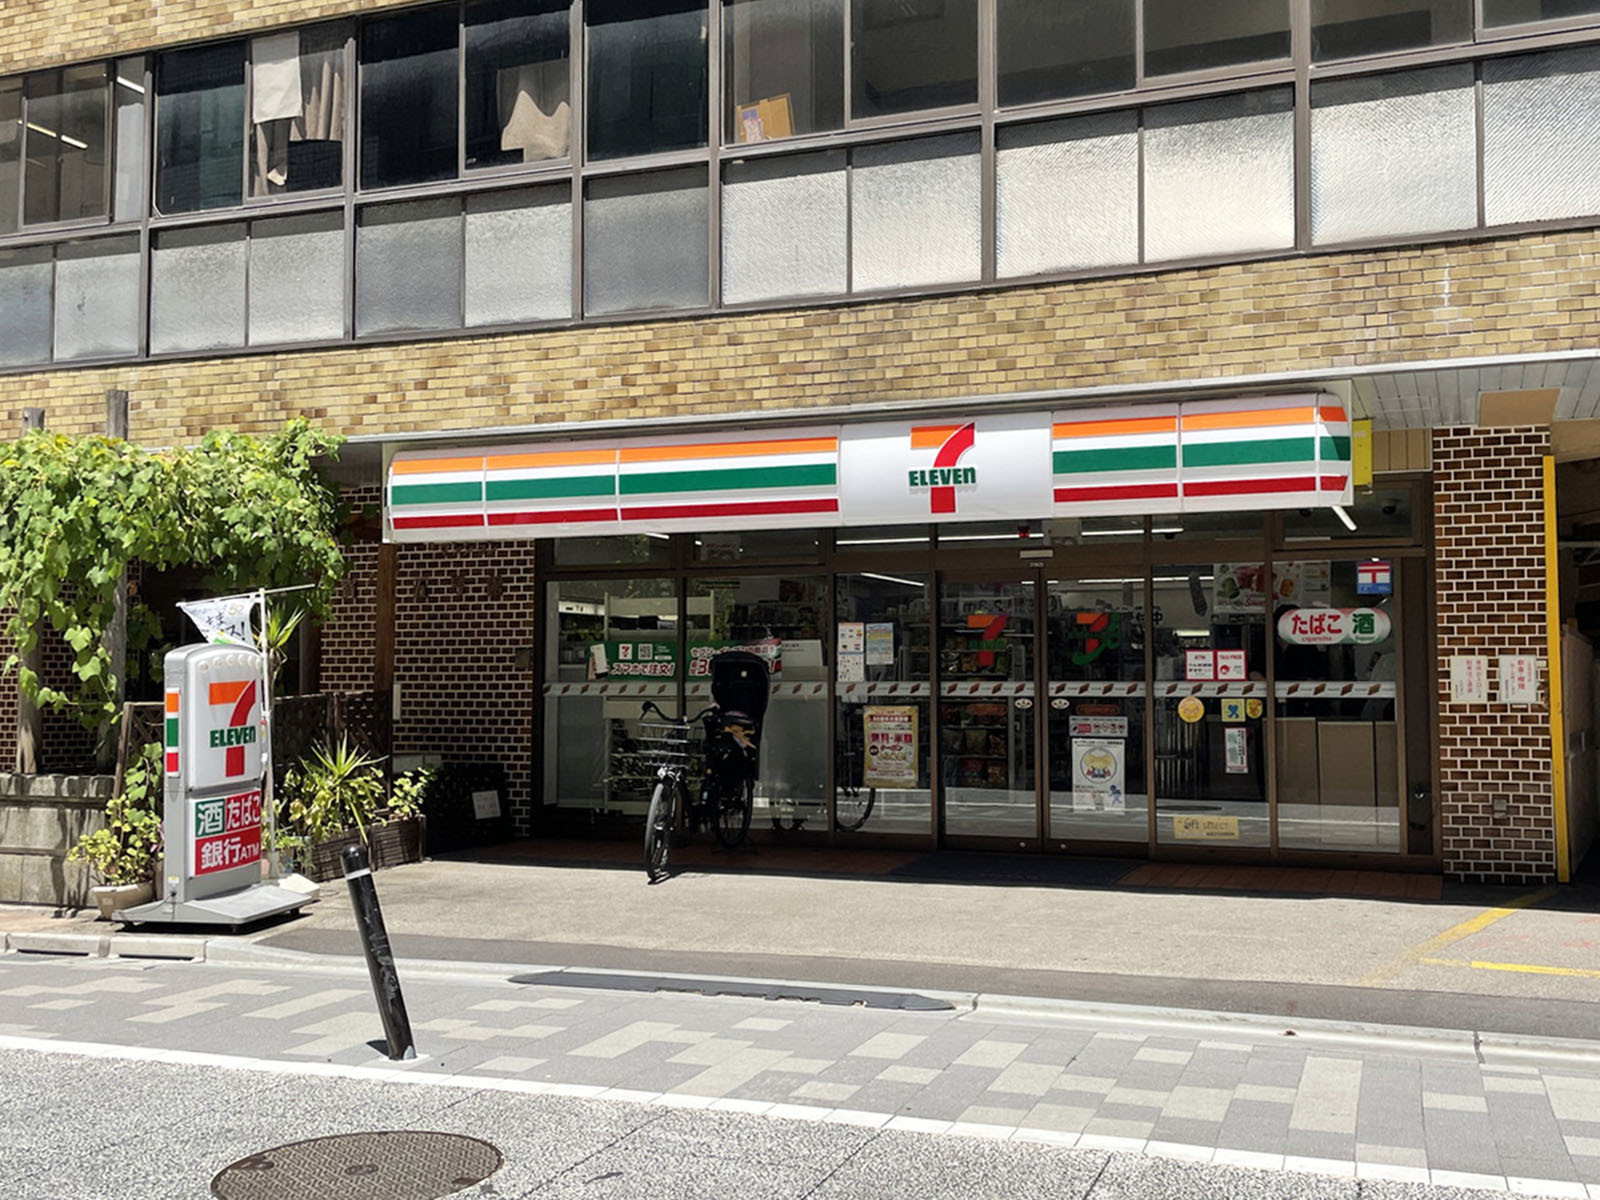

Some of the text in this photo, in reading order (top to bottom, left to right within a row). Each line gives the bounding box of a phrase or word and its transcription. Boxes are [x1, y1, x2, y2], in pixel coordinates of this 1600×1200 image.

[910, 422, 975, 513] 7
[1292, 613, 1374, 635] たばこ 酒
[209, 680, 256, 777] 7
[197, 794, 261, 835] 酒 たばこ
